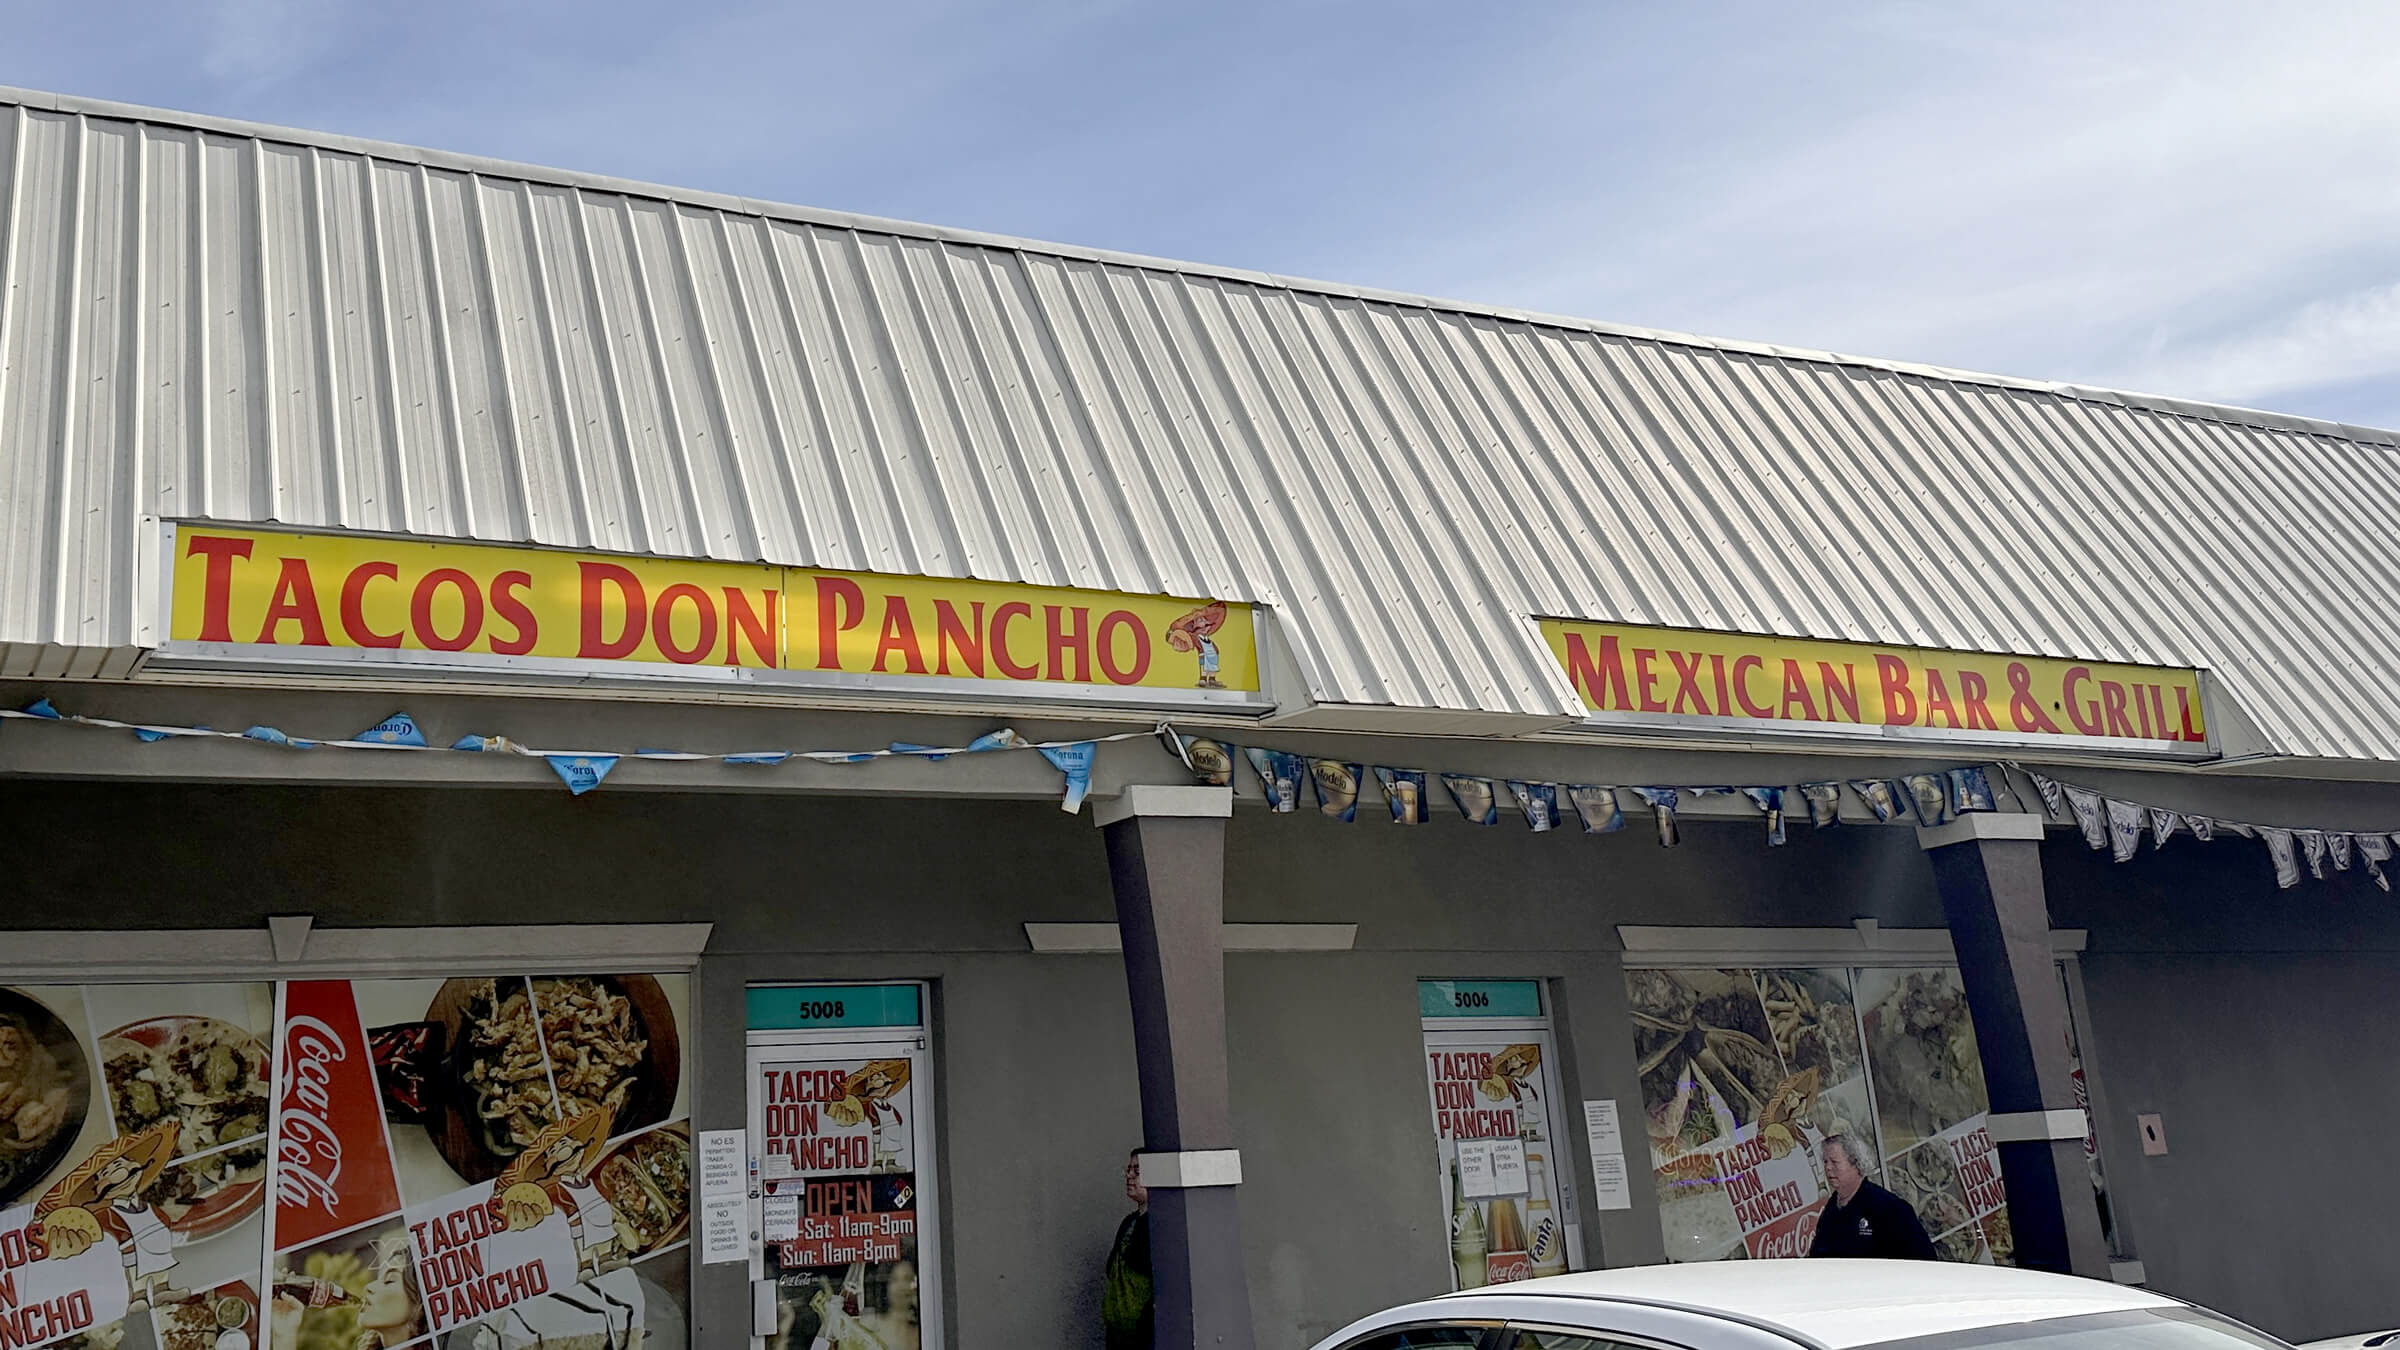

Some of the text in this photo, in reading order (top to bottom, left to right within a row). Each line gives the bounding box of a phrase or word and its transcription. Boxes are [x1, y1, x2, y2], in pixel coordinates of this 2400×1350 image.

[186, 535, 1151, 686] TACOS DON PANCHO
[1564, 632, 2205, 742] MEXICAN BAR & GRILL
[800, 1000, 845, 1020] 5008
[1454, 991, 1489, 1008] 5006
[1429, 1052, 1493, 1081] TACOS
[764, 1069, 848, 1103] TACOS
[1434, 1081, 1475, 1110] DON
[766, 1103, 818, 1137] DON
[1438, 1109, 1516, 1141] PANCHO
[1715, 1135, 1773, 1178] TACOS
[1950, 1127, 1997, 1165] TACO
[1725, 1168, 1764, 1206] DON
[1960, 1154, 1995, 1191] DON
[716, 1210, 728, 1218] NO
[806, 1180, 872, 1217] OPEN
[1735, 1180, 1803, 1233] PANCHO
[410, 1197, 509, 1258] TACOS
[839, 1214, 914, 1238] 11am-9pm
[1530, 1217, 1554, 1263] Fanta
[420, 1243, 484, 1295] DON
[783, 1239, 898, 1266] Sun: 11am-8pm
[428, 1258, 549, 1330] PANCHO
